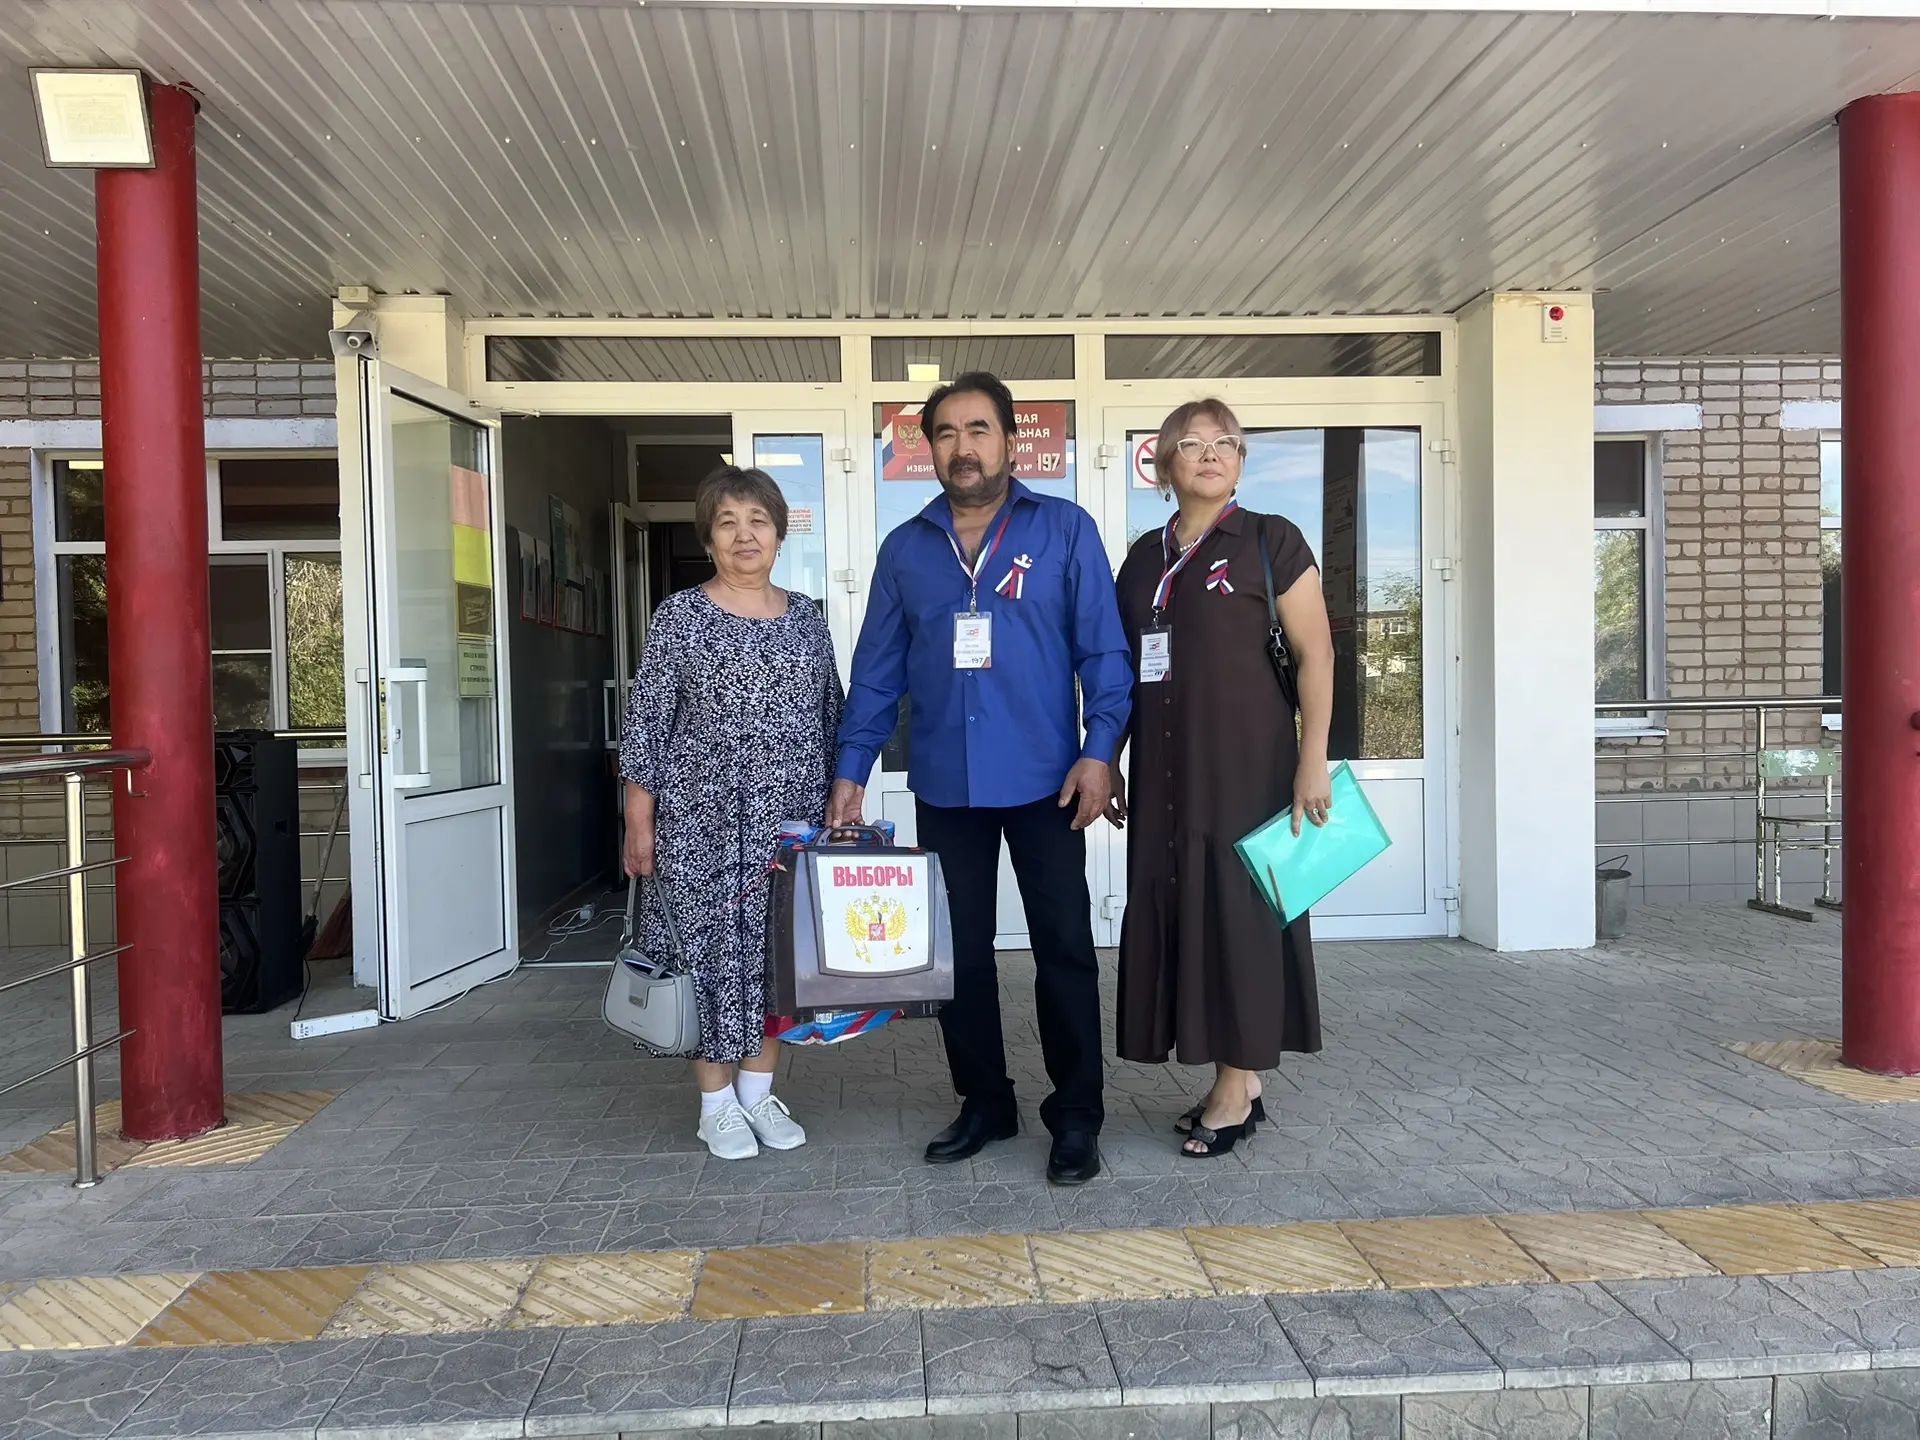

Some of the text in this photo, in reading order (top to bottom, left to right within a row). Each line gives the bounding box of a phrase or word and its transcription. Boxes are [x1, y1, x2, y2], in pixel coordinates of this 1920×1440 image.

[1014, 413, 1038, 424] ВАЯ
[1016, 442, 1033, 453] ИЯ
[906, 464, 935, 473] ИЗБИР
[1037, 452, 1061, 472] 197
[833, 865, 914, 887] ВЫБОРЫ
